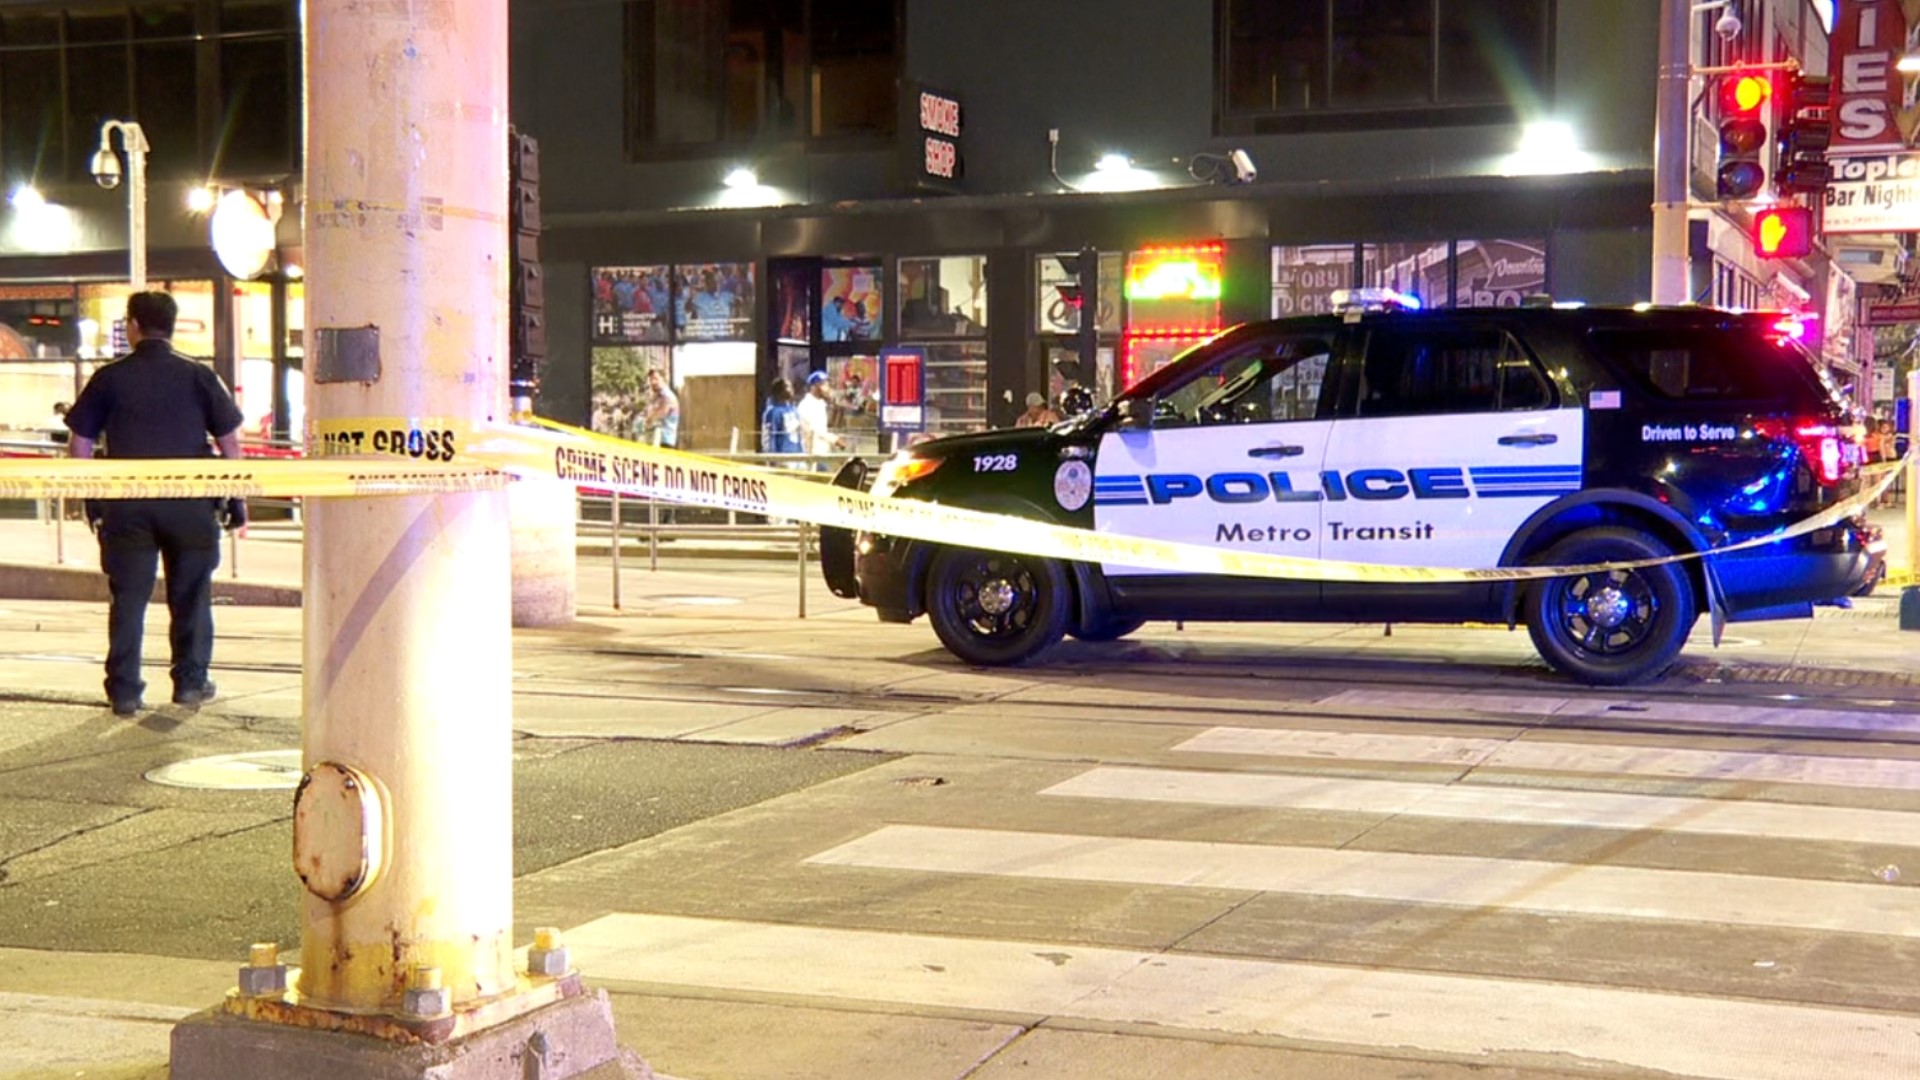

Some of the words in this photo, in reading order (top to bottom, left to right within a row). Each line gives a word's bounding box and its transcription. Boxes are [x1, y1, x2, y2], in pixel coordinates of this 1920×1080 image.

[1840, 0, 1889, 139] IES
[921, 92, 960, 137] SMOKE
[925, 137, 955, 178] SHOP
[324, 430, 365, 455] NOT
[373, 430, 456, 461] CROSS
[1642, 425, 1682, 441] Driven
[1684, 426, 1697, 440] to
[1700, 424, 1735, 440] Serve
[555, 446, 607, 482] CRIME
[612, 455, 659, 489] SCENE
[664, 465, 685, 490] DO
[690, 469, 718, 496] NOT
[723, 474, 768, 505] CROSS
[973, 454, 1018, 472] 1928
[1145, 467, 1471, 504] POLICE
[1215, 523, 1311, 542] Metro
[1328, 520, 1434, 541] Transit
